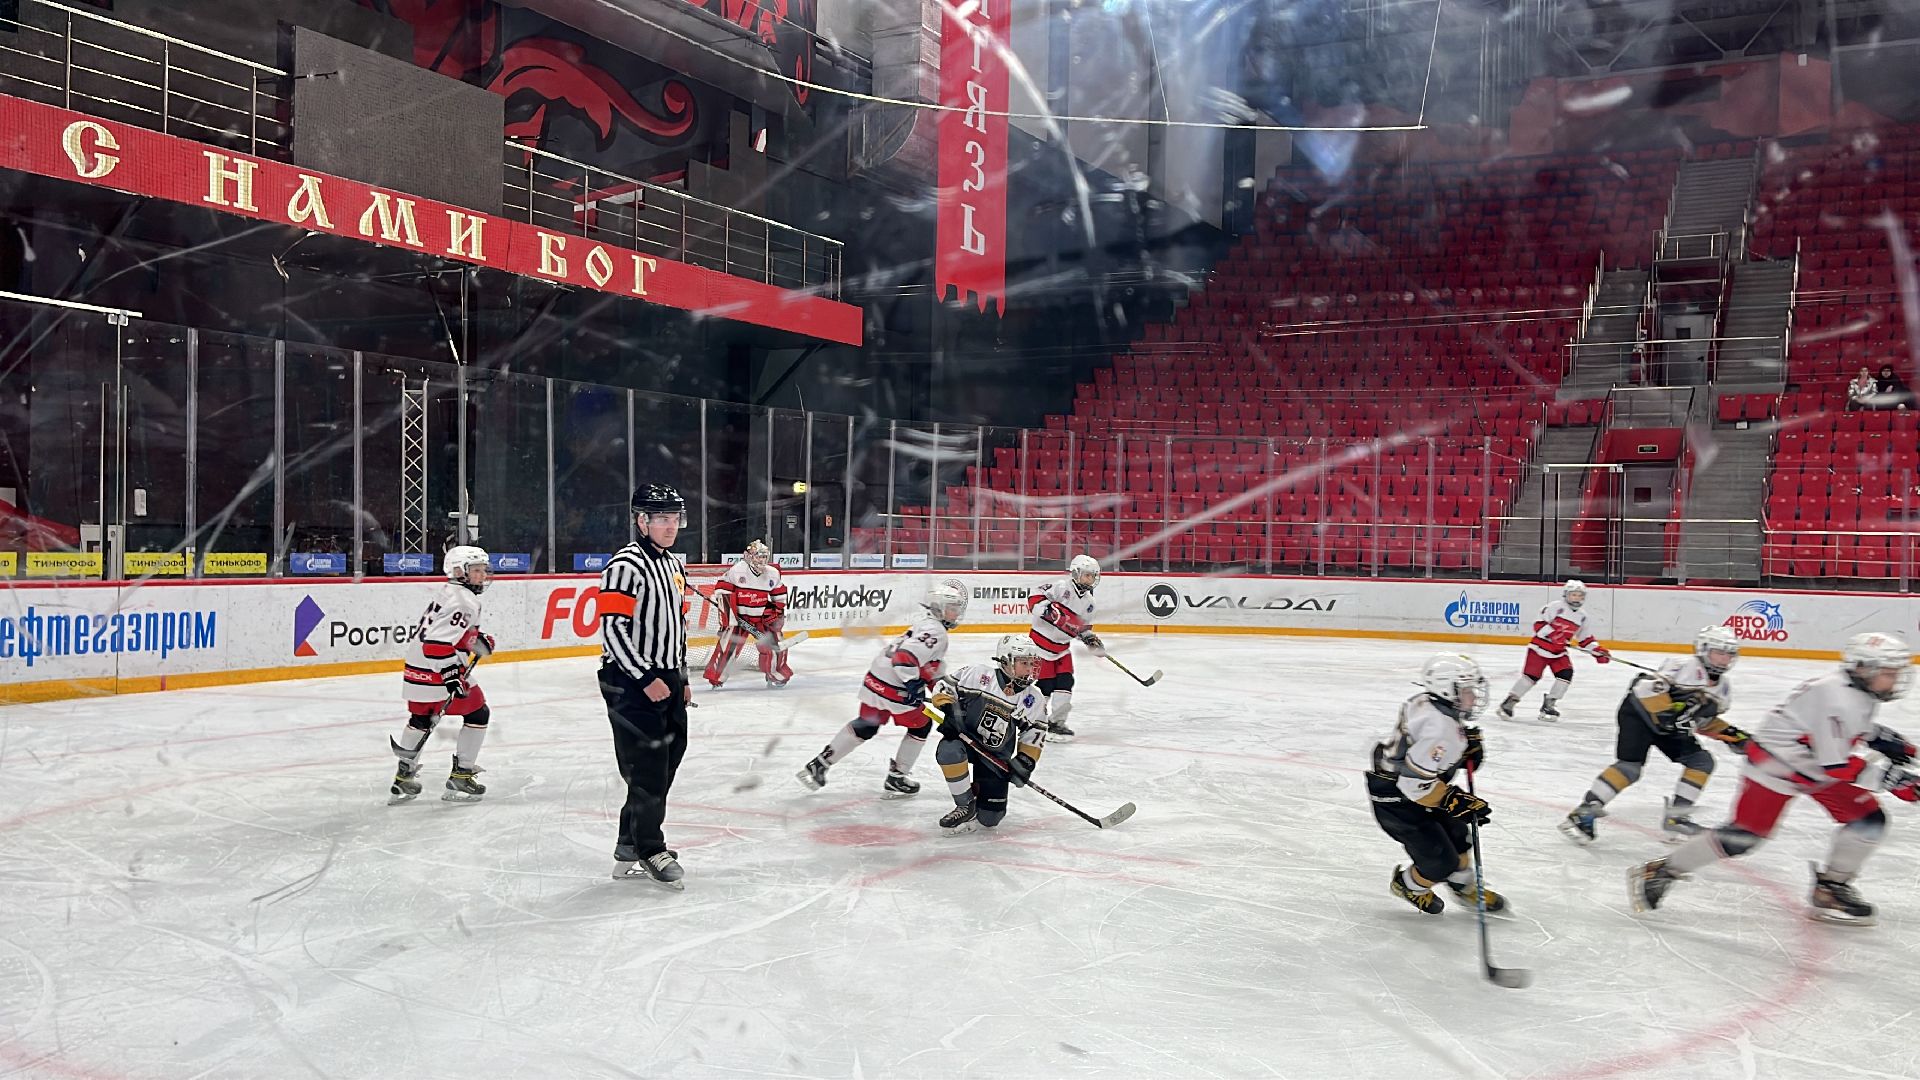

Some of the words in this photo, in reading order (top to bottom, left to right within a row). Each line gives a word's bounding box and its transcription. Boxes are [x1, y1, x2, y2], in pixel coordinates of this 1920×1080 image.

[62, 120, 120, 179] С
[203, 150, 487, 261] НАМИ
[537, 231, 657, 296] БОГ
[209, 559, 262, 567] ТИНЬКОФФ
[1184, 595, 1337, 611] VALDAI
[1470, 601, 1520, 616] ГАЗПРОМ
[449, 611, 471, 629] 95
[1471, 615, 1519, 623] ТРАНСГАЗ
[1721, 615, 1765, 629] АВТО
[1734, 627, 1788, 642] РАДИО
